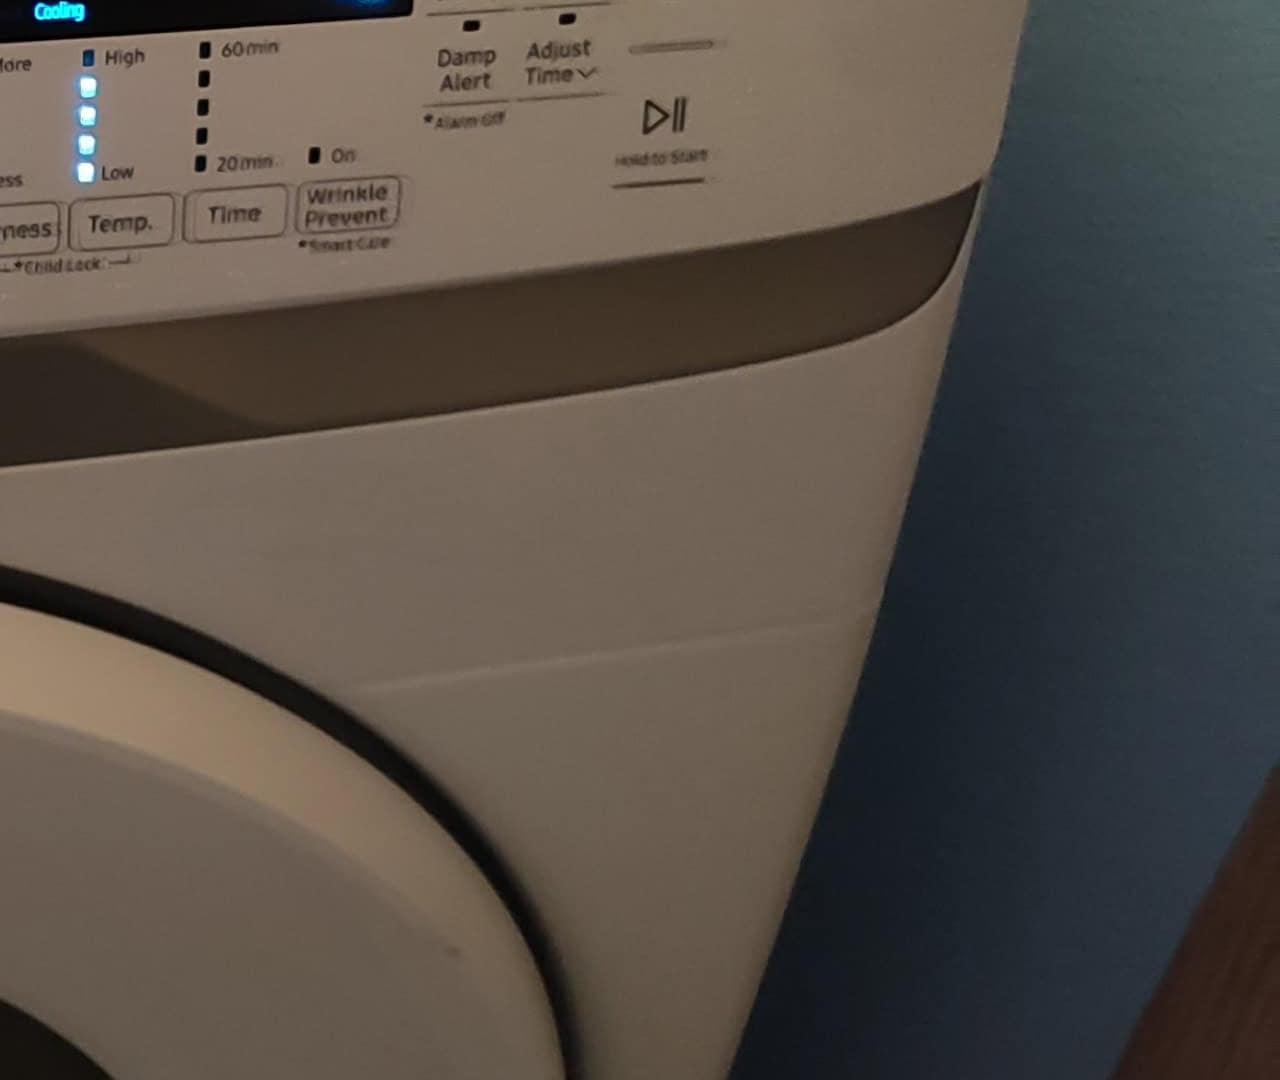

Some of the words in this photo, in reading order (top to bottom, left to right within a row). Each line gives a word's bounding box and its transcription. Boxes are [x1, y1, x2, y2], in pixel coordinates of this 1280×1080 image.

[34, 1, 86, 22] Cooling
[104, 48, 145, 68] High
[437, 49, 497, 68] Damp
[526, 40, 591, 61] Adjust
[440, 72, 492, 92] Alert
[525, 67, 574, 85] Time
[331, 148, 356, 164] On
[101, 166, 134, 181] Low
[307, 183, 388, 204] Wrinkle
[89, 214, 153, 235] Temp.
[209, 206, 262, 224] Time
[305, 206, 389, 227] Prevent
